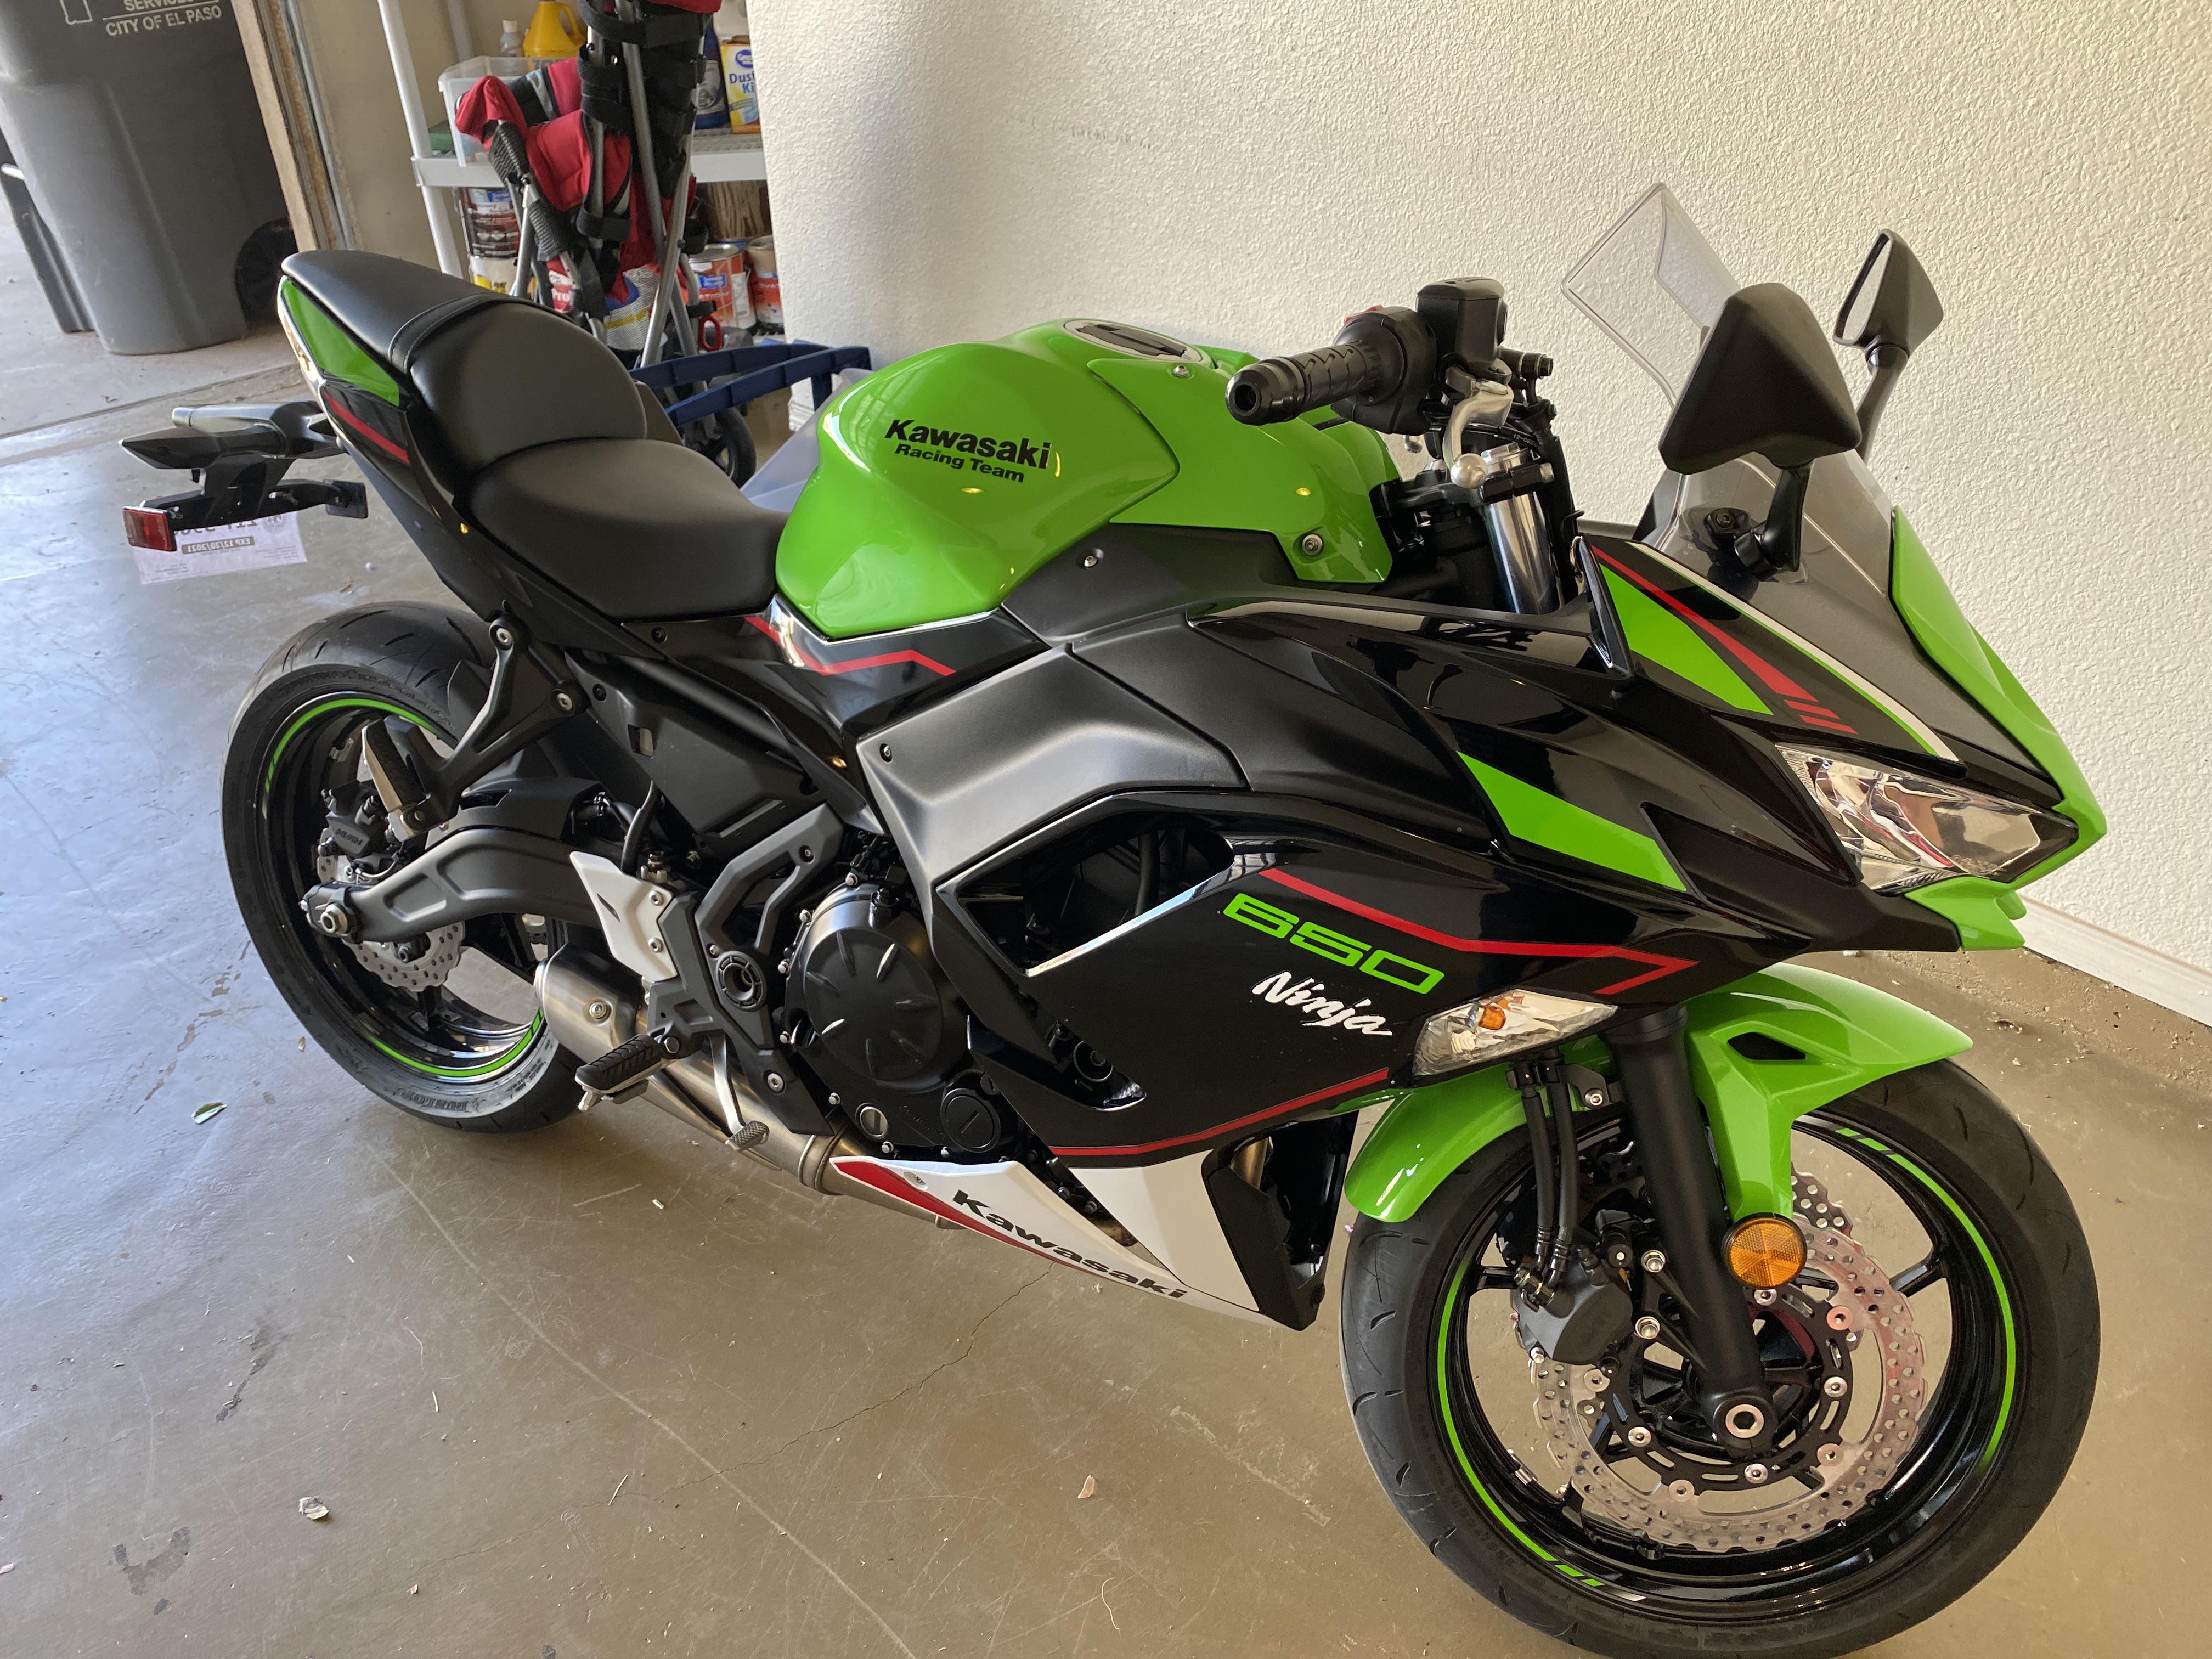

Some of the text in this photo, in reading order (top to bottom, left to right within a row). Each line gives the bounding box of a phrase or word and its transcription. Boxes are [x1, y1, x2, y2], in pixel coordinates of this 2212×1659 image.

[106, 5, 222, 36] CITY OF EL PASO
[884, 419, 1052, 470] Kawasaki
[895, 443, 1025, 483] Racing Team
[1223, 893, 1445, 995] 650
[1251, 971, 1393, 1036] Ninja
[952, 1189, 1188, 1299] Kawasaki
